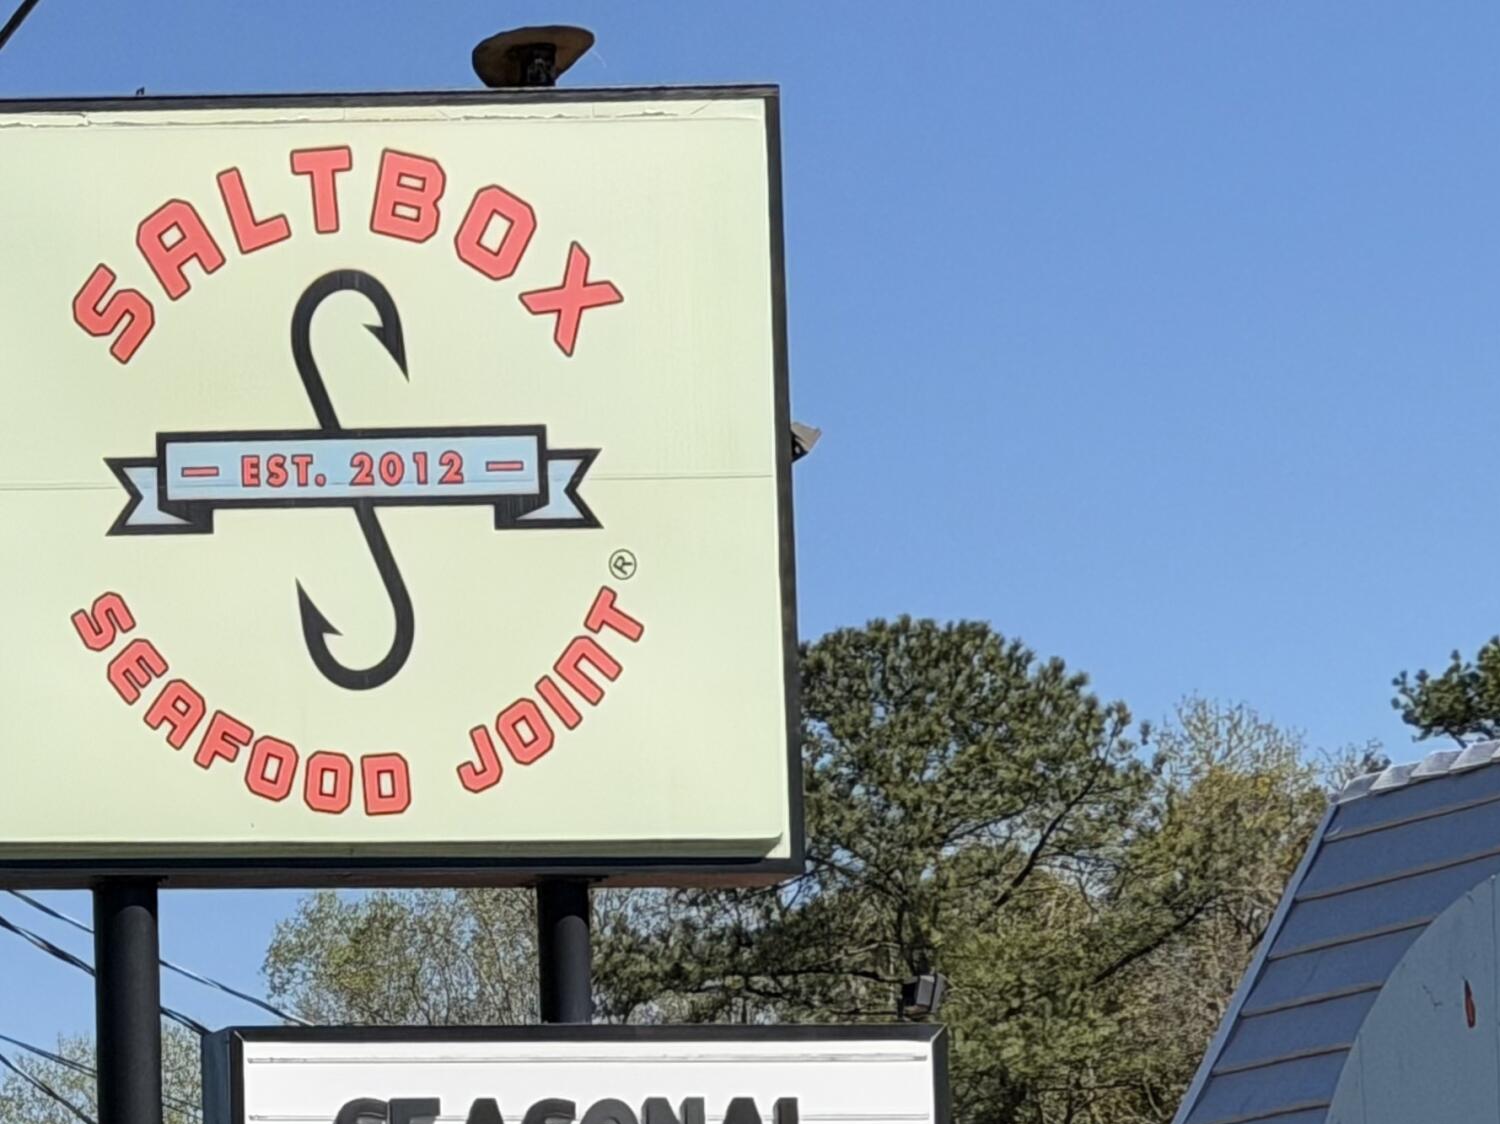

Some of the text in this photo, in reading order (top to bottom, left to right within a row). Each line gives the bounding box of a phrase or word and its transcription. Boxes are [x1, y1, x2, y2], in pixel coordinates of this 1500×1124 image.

[72, 145, 623, 364] SALTBOX
[241, 450, 465, 488] EST. 2012
[71, 591, 412, 815] SEAFOOD
